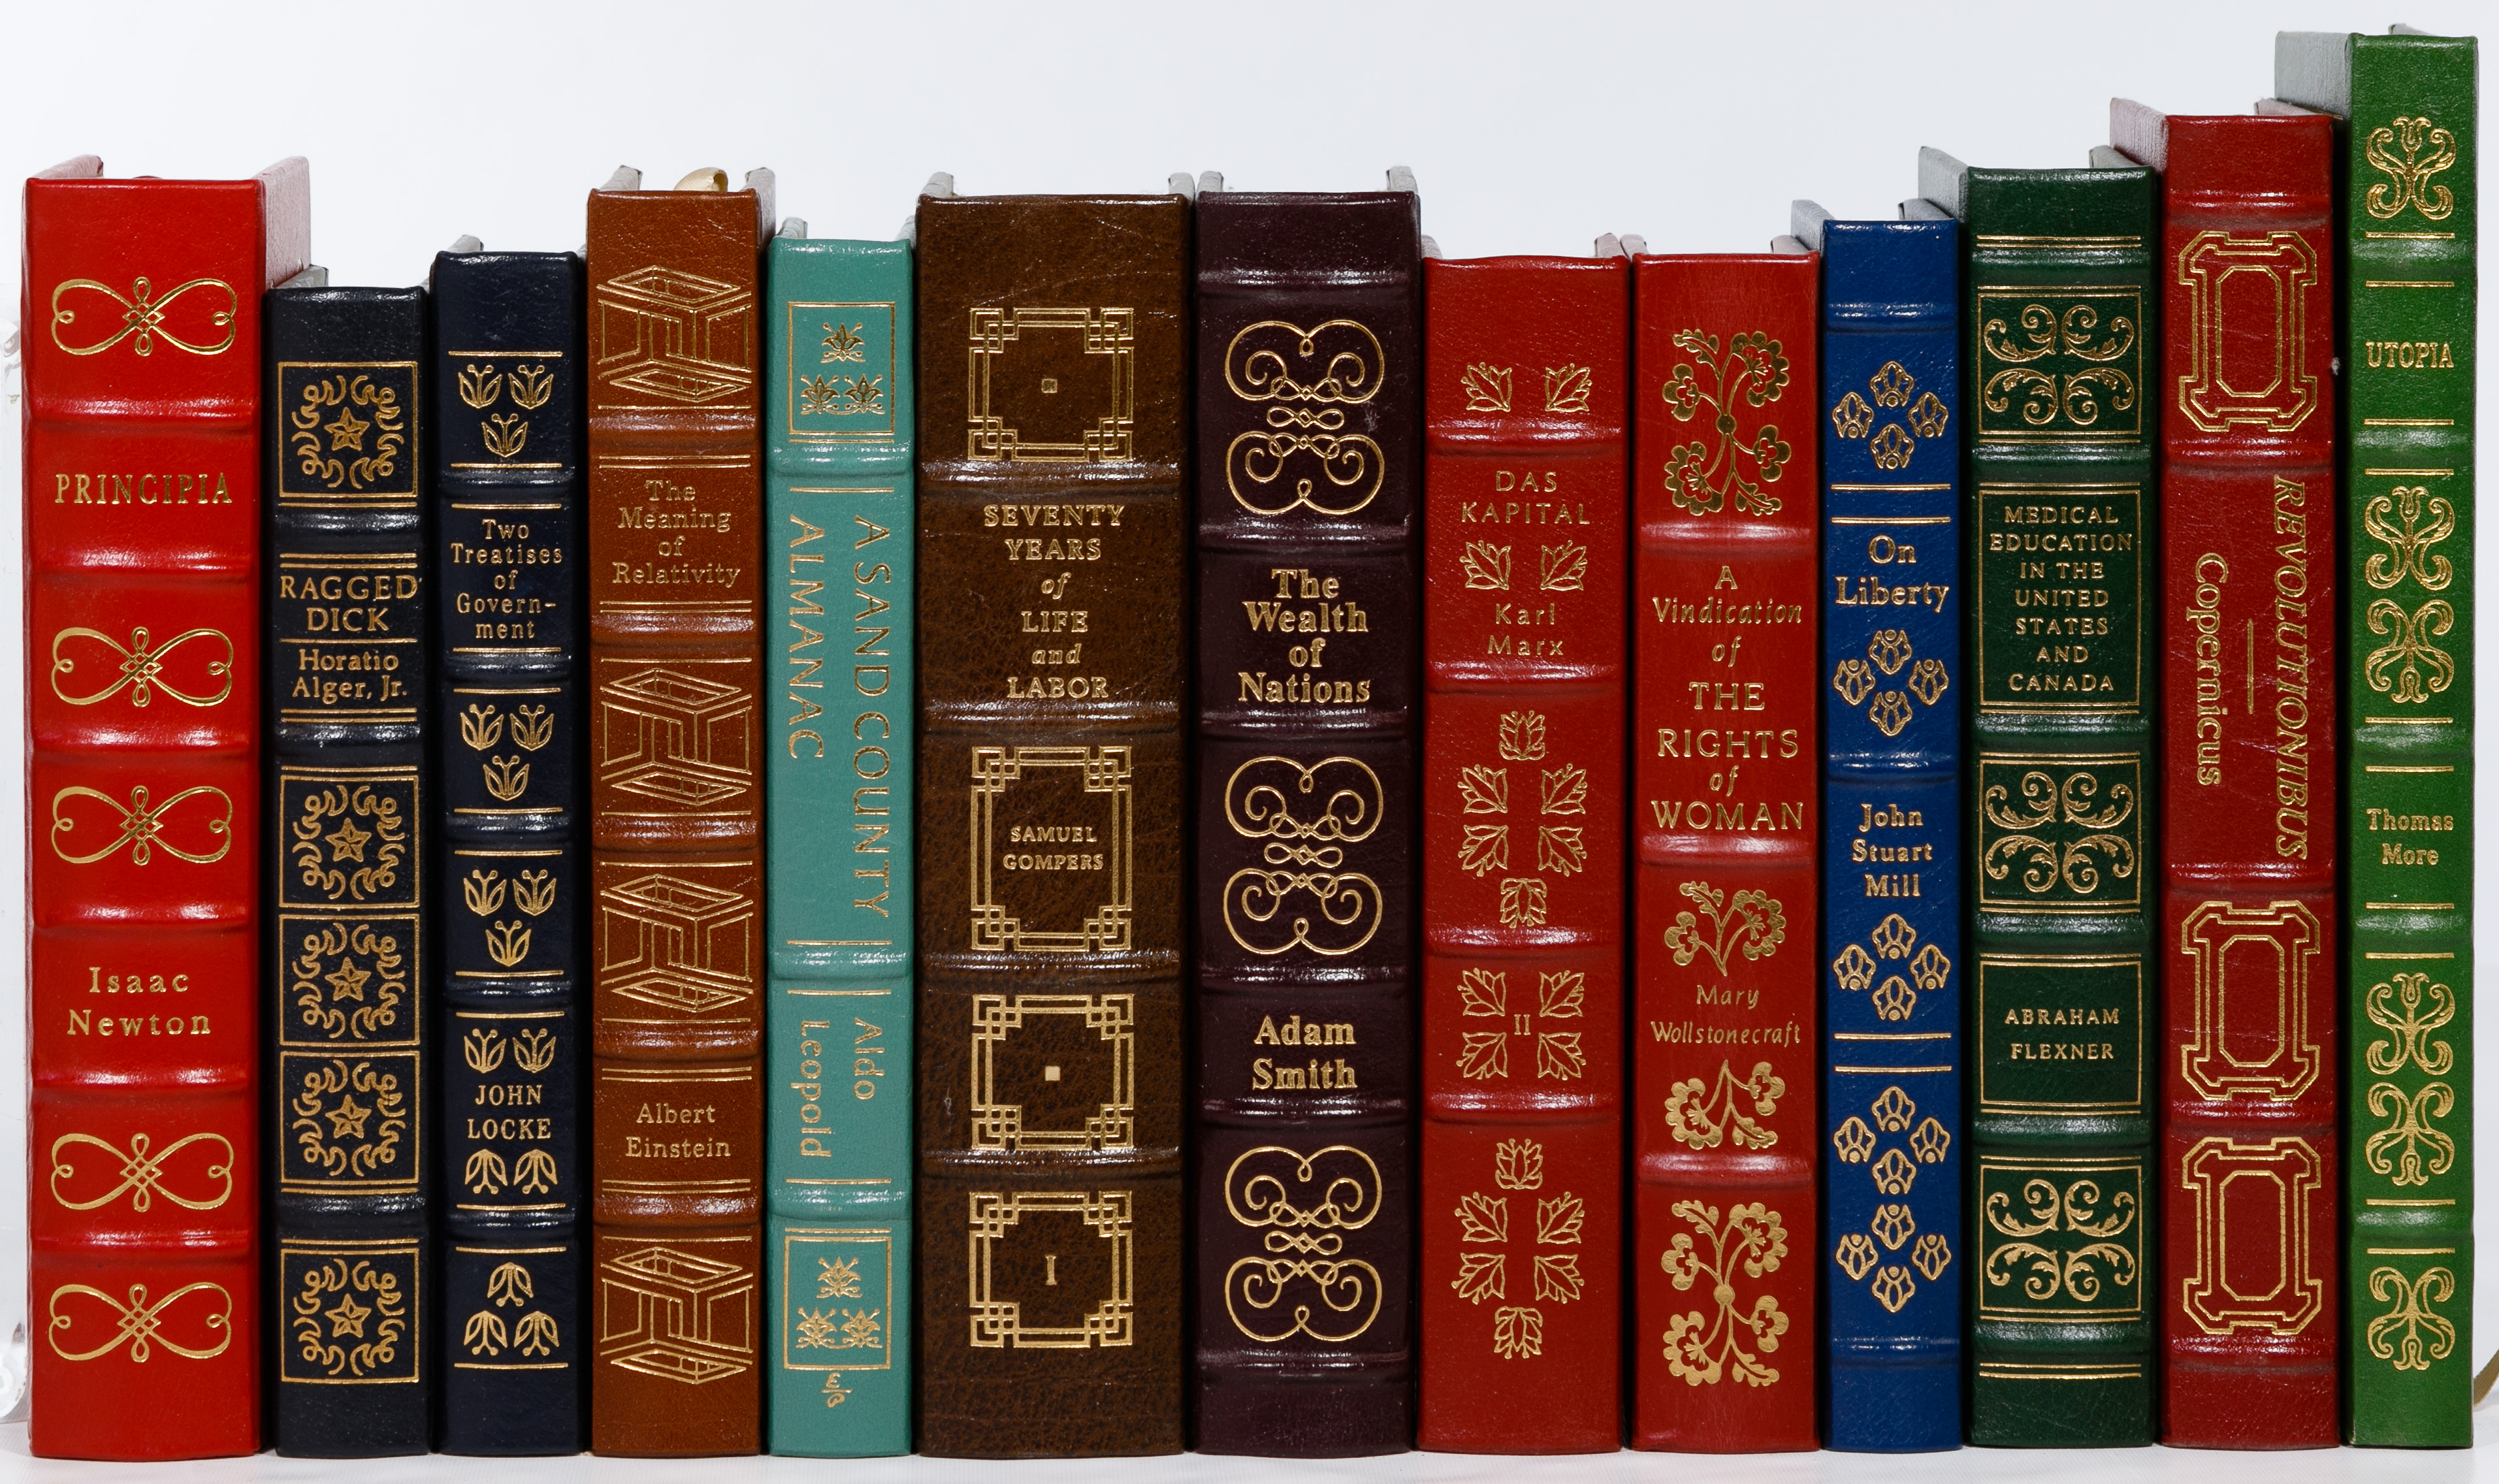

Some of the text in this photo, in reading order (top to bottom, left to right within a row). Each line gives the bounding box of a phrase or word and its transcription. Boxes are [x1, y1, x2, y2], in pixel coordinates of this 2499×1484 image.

[2364, 341, 2455, 369] UTOPIA
[54, 472, 233, 506] PRINCIPIA
[644, 479, 696, 502] The
[1496, 470, 1557, 493] DAS
[617, 506, 732, 534] Meaning
[983, 504, 1125, 528] SEVENTY
[1461, 501, 1590, 526] KAPITAL
[2004, 506, 2119, 524] MEDICAL
[481, 518, 529, 540] Two
[450, 542, 562, 565] Treatises
[658, 535, 686, 557] of
[1004, 538, 1101, 561] YEARS
[1869, 534, 1917, 564] On
[1990, 533, 2133, 553] EDUCATION
[494, 569, 519, 590] of
[611, 561, 741, 589] Relativity
[1714, 564, 1739, 590] A
[2020, 562, 2104, 579] IN THE
[280, 574, 418, 602] RAGGED
[1041, 572, 1072, 600] of
[1271, 568, 1340, 600] The
[1835, 576, 1950, 613] Liberty
[456, 592, 556, 614] Govern-
[1651, 596, 1802, 625] Vindication
[2015, 589, 2109, 607] UNITED
[306, 607, 389, 632] DICK
[1020, 610, 1089, 634] LIFE
[1242, 601, 1369, 634] Wealth
[1495, 602, 1555, 626] Karl
[2016, 617, 2108, 636] STATES
[475, 621, 535, 639] ment
[788, 513, 825, 760] ALMANAC
[1031, 643, 1082, 665] and
[1289, 637, 1327, 668] of
[1487, 635, 1564, 656] Marx
[1711, 636, 1742, 668] of
[2036, 645, 2089, 664] AND
[298, 648, 399, 671] Horatio
[2185, 552, 2229, 786] Copernicus
[2273, 474, 2310, 860] REVOLUTIONIBUS
[292, 674, 408, 705] Alger, Jr.
[1007, 676, 1109, 700] LABOR
[1238, 671, 1370, 704] Nations
[2008, 673, 2114, 692] CANADA
[1688, 681, 1765, 711] THE
[853, 515, 892, 918] A SAND COUNTY
[1657, 728, 1798, 759] RIGHTS
[1709, 764, 1739, 798] of
[1650, 799, 1804, 831] WOMAN
[1858, 803, 1924, 833] John
[2366, 807, 2454, 831] Thomas
[1010, 826, 1097, 843] SAMUEL
[1003, 853, 1104, 871] GOMPERS
[1852, 838, 1933, 863] Stuart
[2381, 843, 2439, 866] More
[1864, 873, 1921, 897] Mill
[89, 966, 189, 994] Isaac
[1696, 984, 1760, 1010] Mary
[67, 1008, 211, 1037] Newton
[1513, 1013, 1532, 1036] II
[2004, 1008, 2120, 1025] ABRAHAM
[1253, 1015, 1357, 1046] Adam
[1650, 1020, 1801, 1048] Wollstonecraft
[853, 1017, 885, 1101] Aldo
[2010, 1042, 2114, 1060] FLEXNER
[1252, 1057, 1358, 1090] Smith
[474, 1084, 543, 1106] JOHN
[790, 1020, 832, 1158] Leopold
[636, 1103, 716, 1124] Albert
[467, 1118, 551, 1140] LOCKE
[625, 1136, 732, 1158] Einstein
[1045, 1254, 1057, 1286] I
